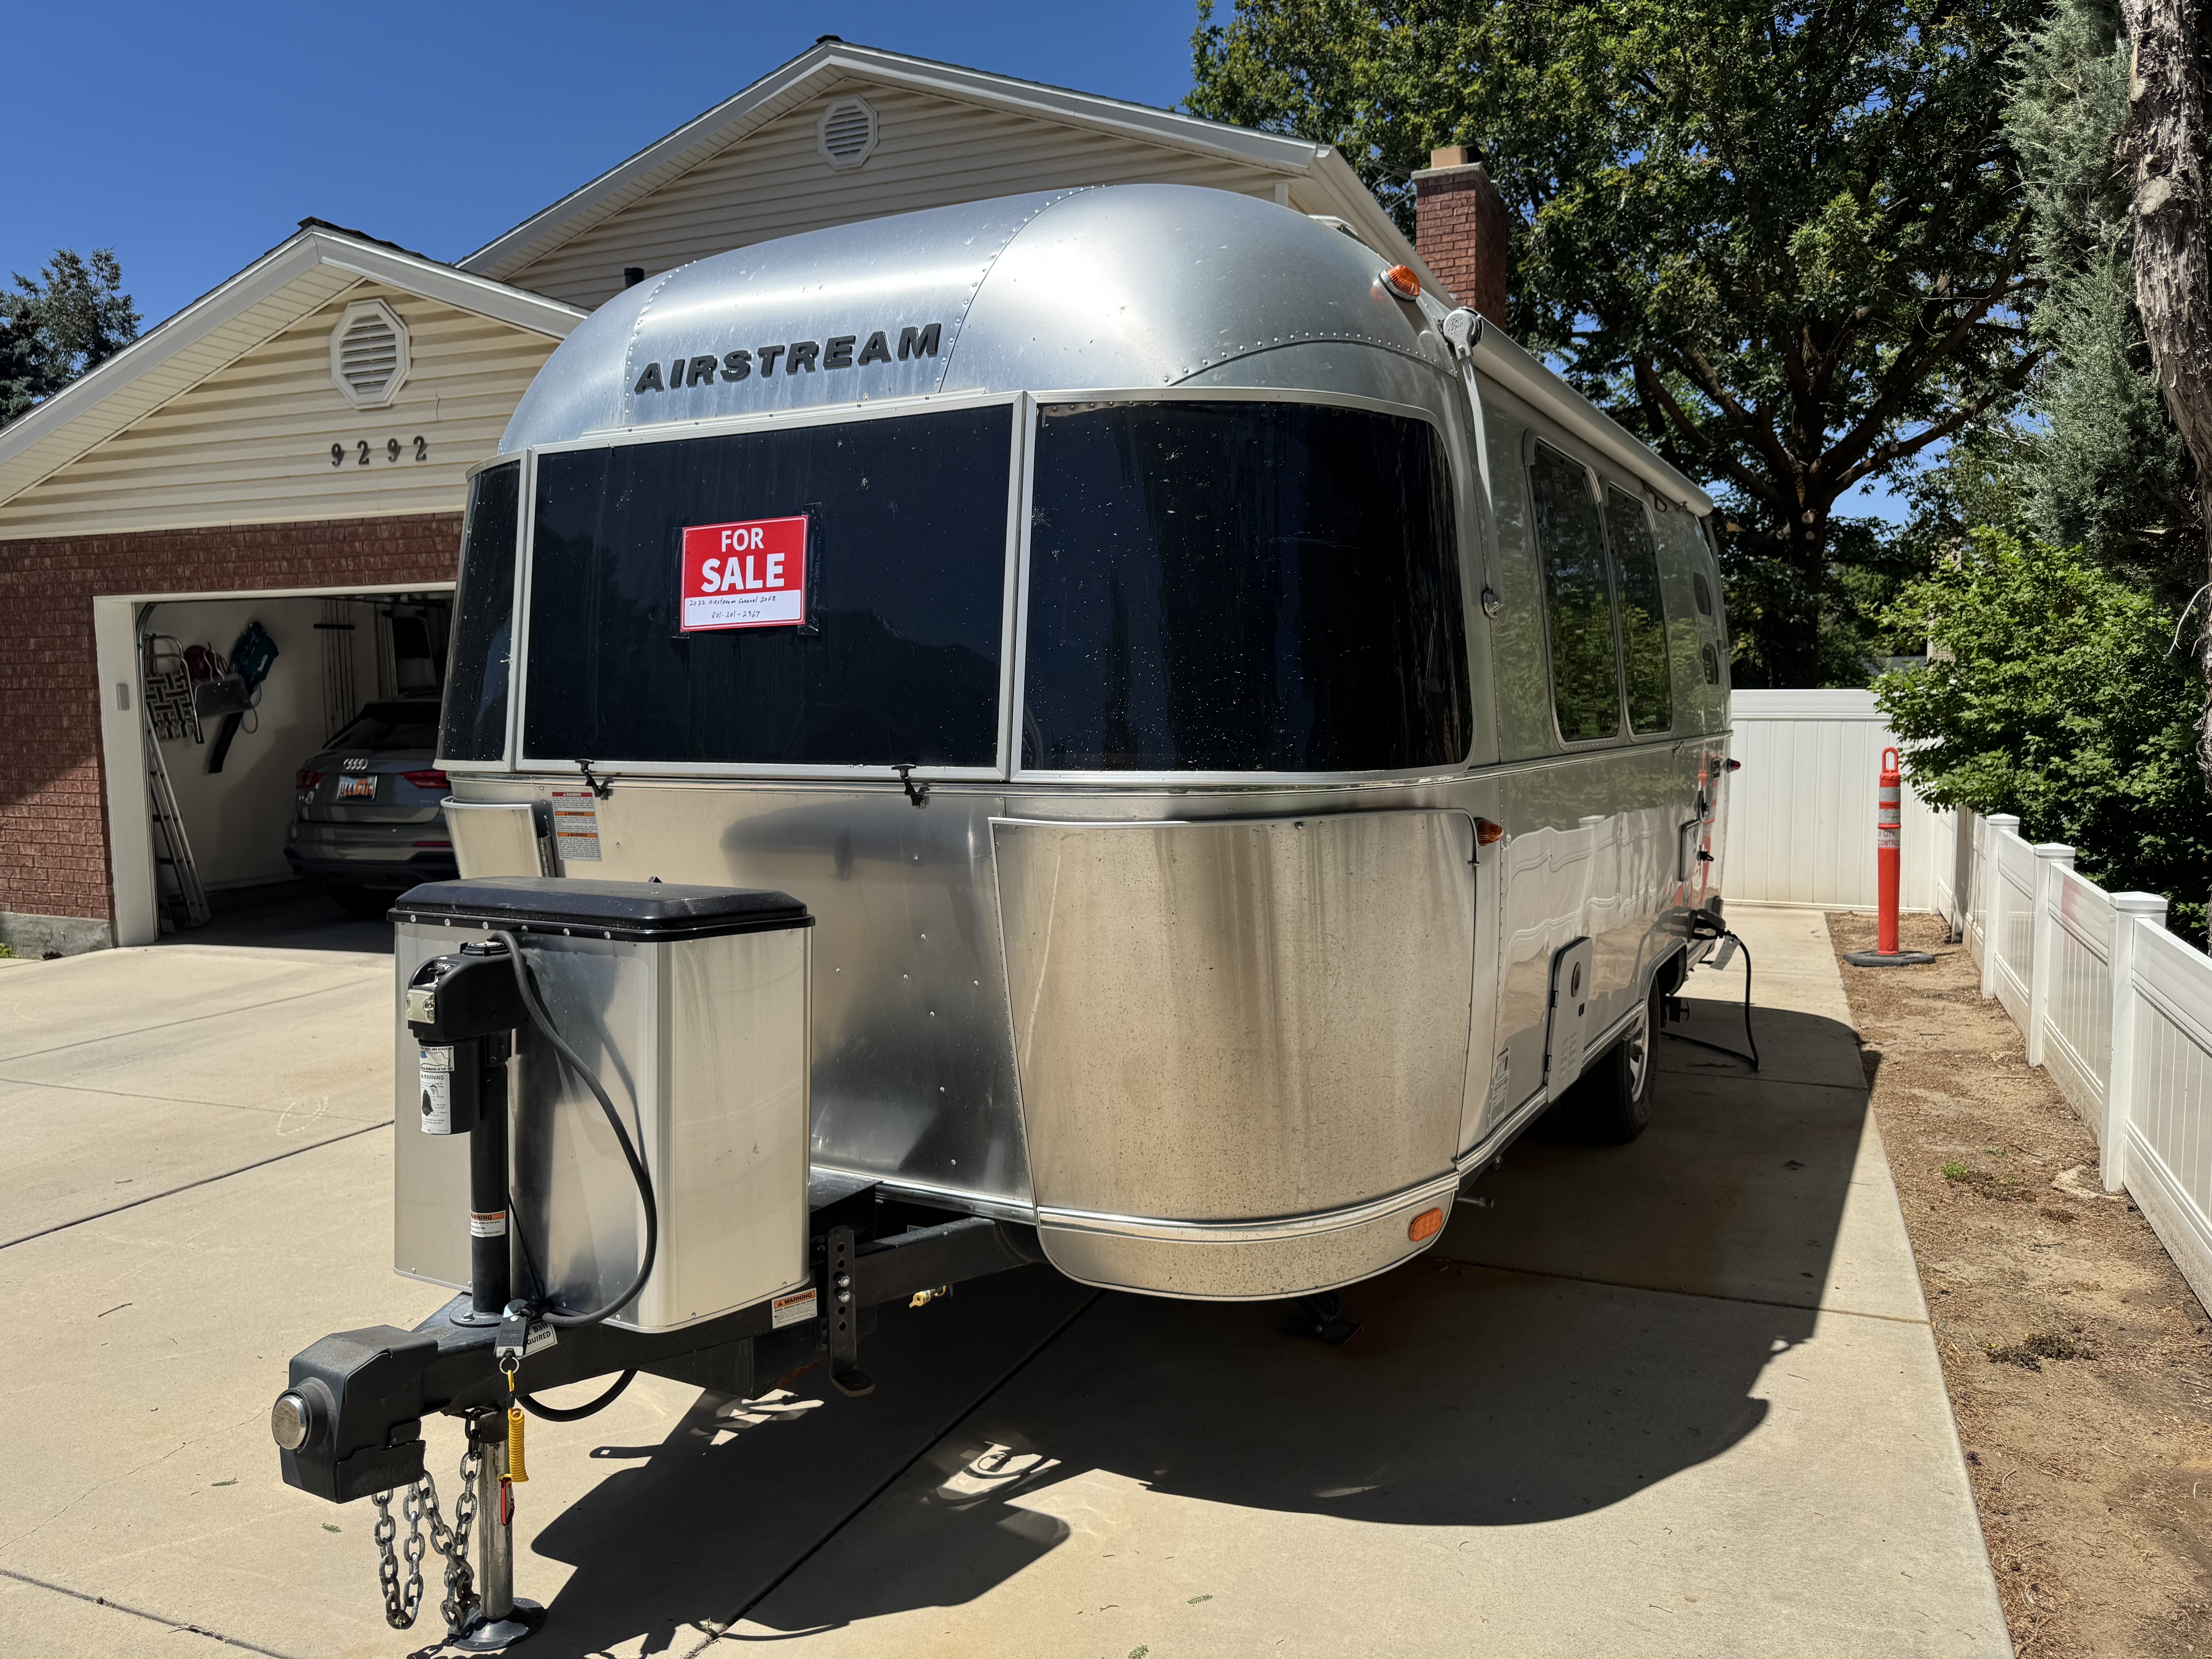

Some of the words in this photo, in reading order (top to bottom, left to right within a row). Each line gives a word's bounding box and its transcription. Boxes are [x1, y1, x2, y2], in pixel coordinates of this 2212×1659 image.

[634, 323, 941, 395] AIRSTREAM
[331, 435, 427, 467] 9292
[721, 527, 764, 552] FOR
[701, 553, 785, 593] SALE
[784, 1292, 812, 1304] WARNING
[527, 1331, 551, 1345] QUIRED
[532, 1322, 548, 1333] Ball
